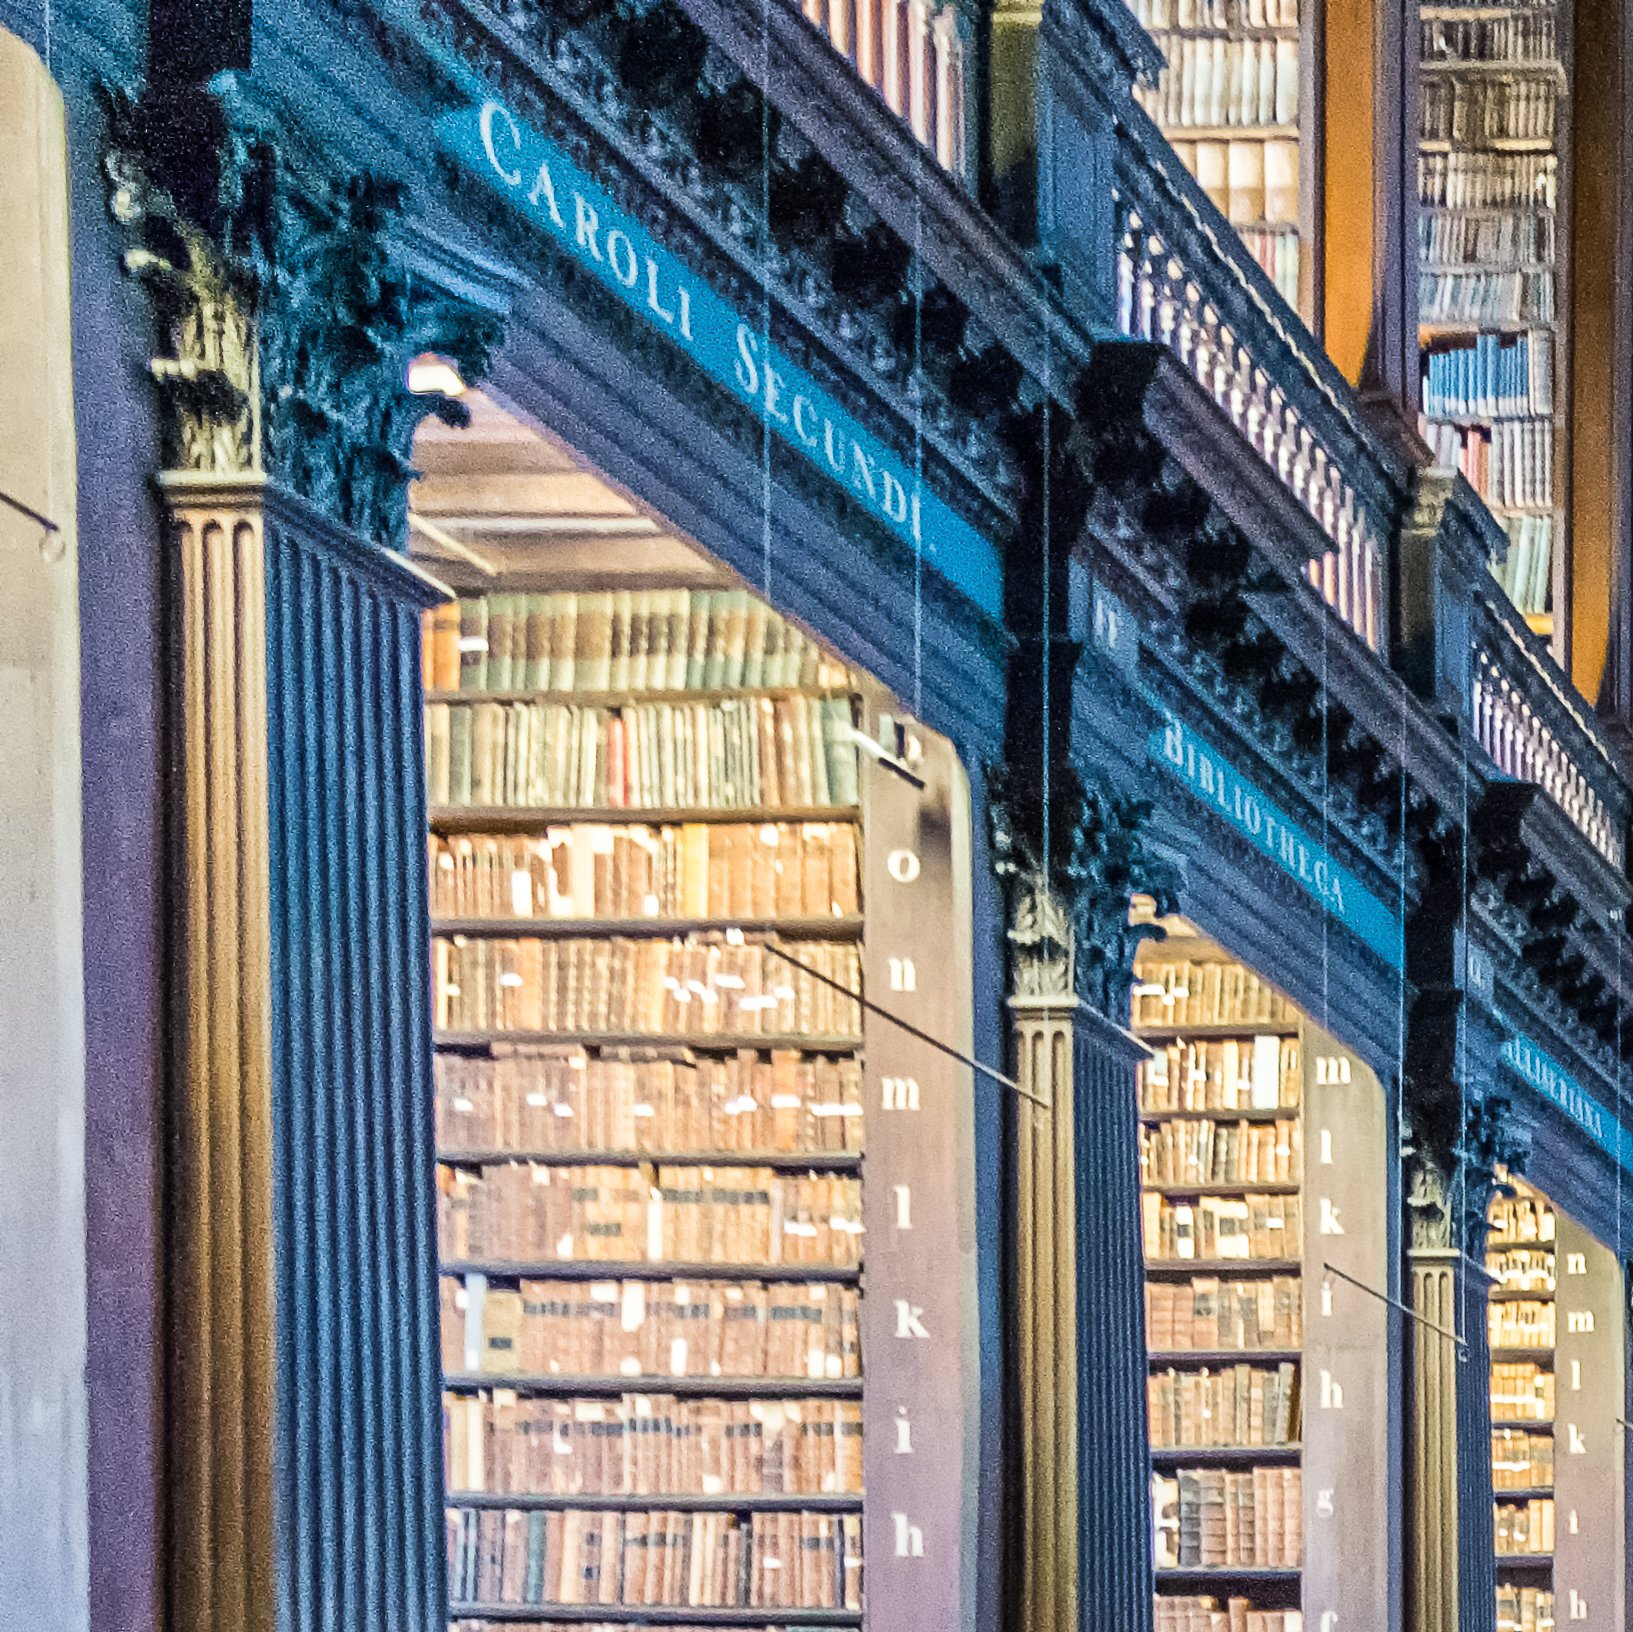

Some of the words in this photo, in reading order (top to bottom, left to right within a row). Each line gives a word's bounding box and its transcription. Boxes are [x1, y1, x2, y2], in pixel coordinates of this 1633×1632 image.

[478, 101, 694, 342] CAROLI
[1164, 717, 1345, 915] BIBLIOTHECA
[887, 850, 920, 882] o
[888, 957, 916, 992] n
[1316, 1057, 1351, 1085] m
[882, 1078, 920, 1111] m
[1320, 1129, 1333, 1164] l
[894, 1185, 912, 1229] l
[1319, 1198, 1345, 1234] k
[1321, 1282, 1332, 1316] i
[895, 1300, 930, 1338] k
[1320, 1370, 1343, 1409] h
[894, 1411, 913, 1454] i
[1317, 1488, 1334, 1517] g
[892, 1513, 924, 1557] h
